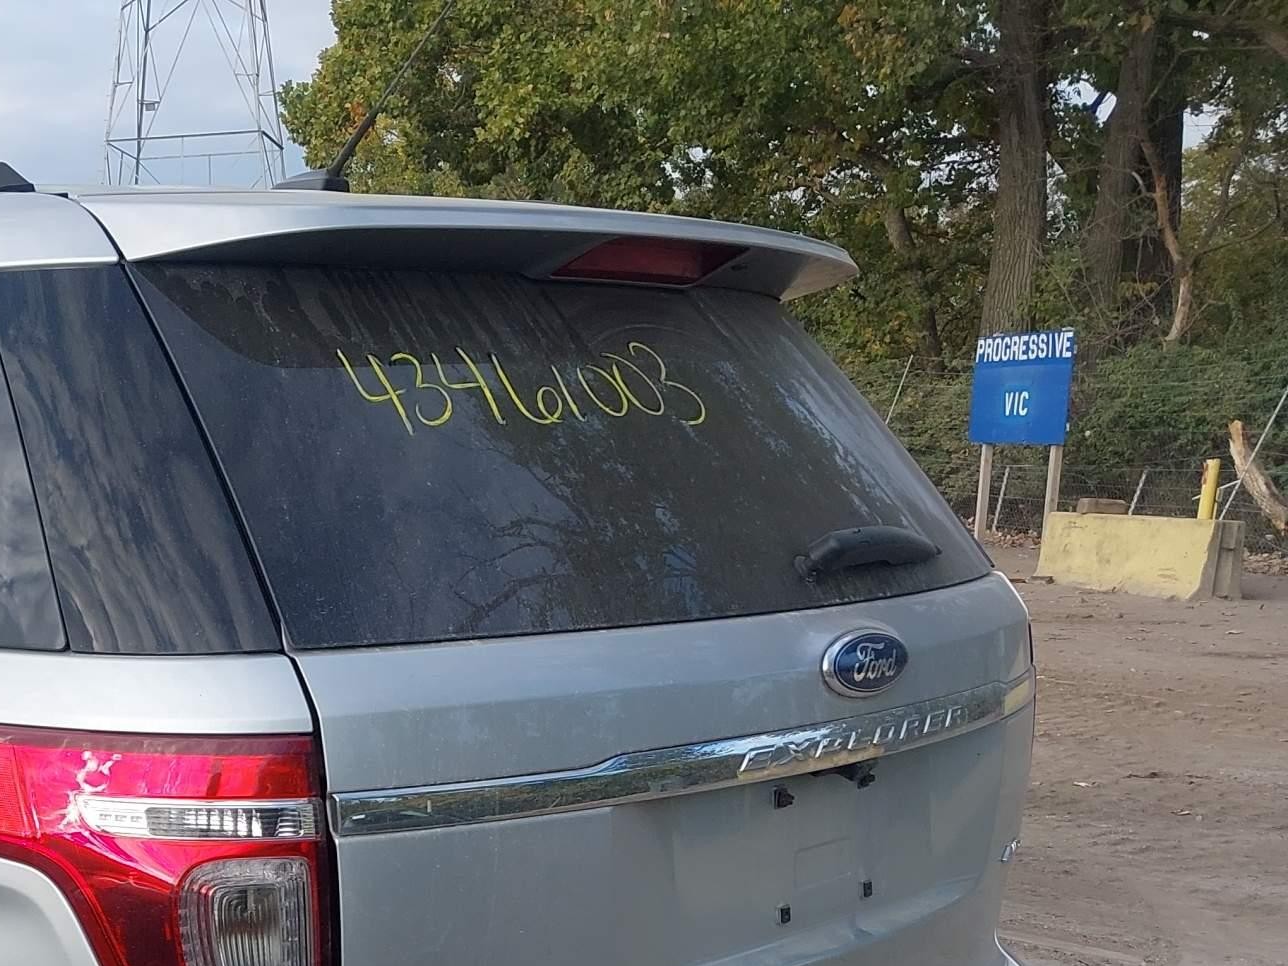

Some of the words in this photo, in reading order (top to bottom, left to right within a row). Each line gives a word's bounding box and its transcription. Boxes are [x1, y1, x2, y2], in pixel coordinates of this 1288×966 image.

[975, 332, 1074, 362] PROGRESSIVE
[335, 341, 706, 436] 43461003
[1004, 391, 1029, 416] VIC
[852, 641, 898, 683] Ford
[738, 704, 969, 774] EXPLORER
